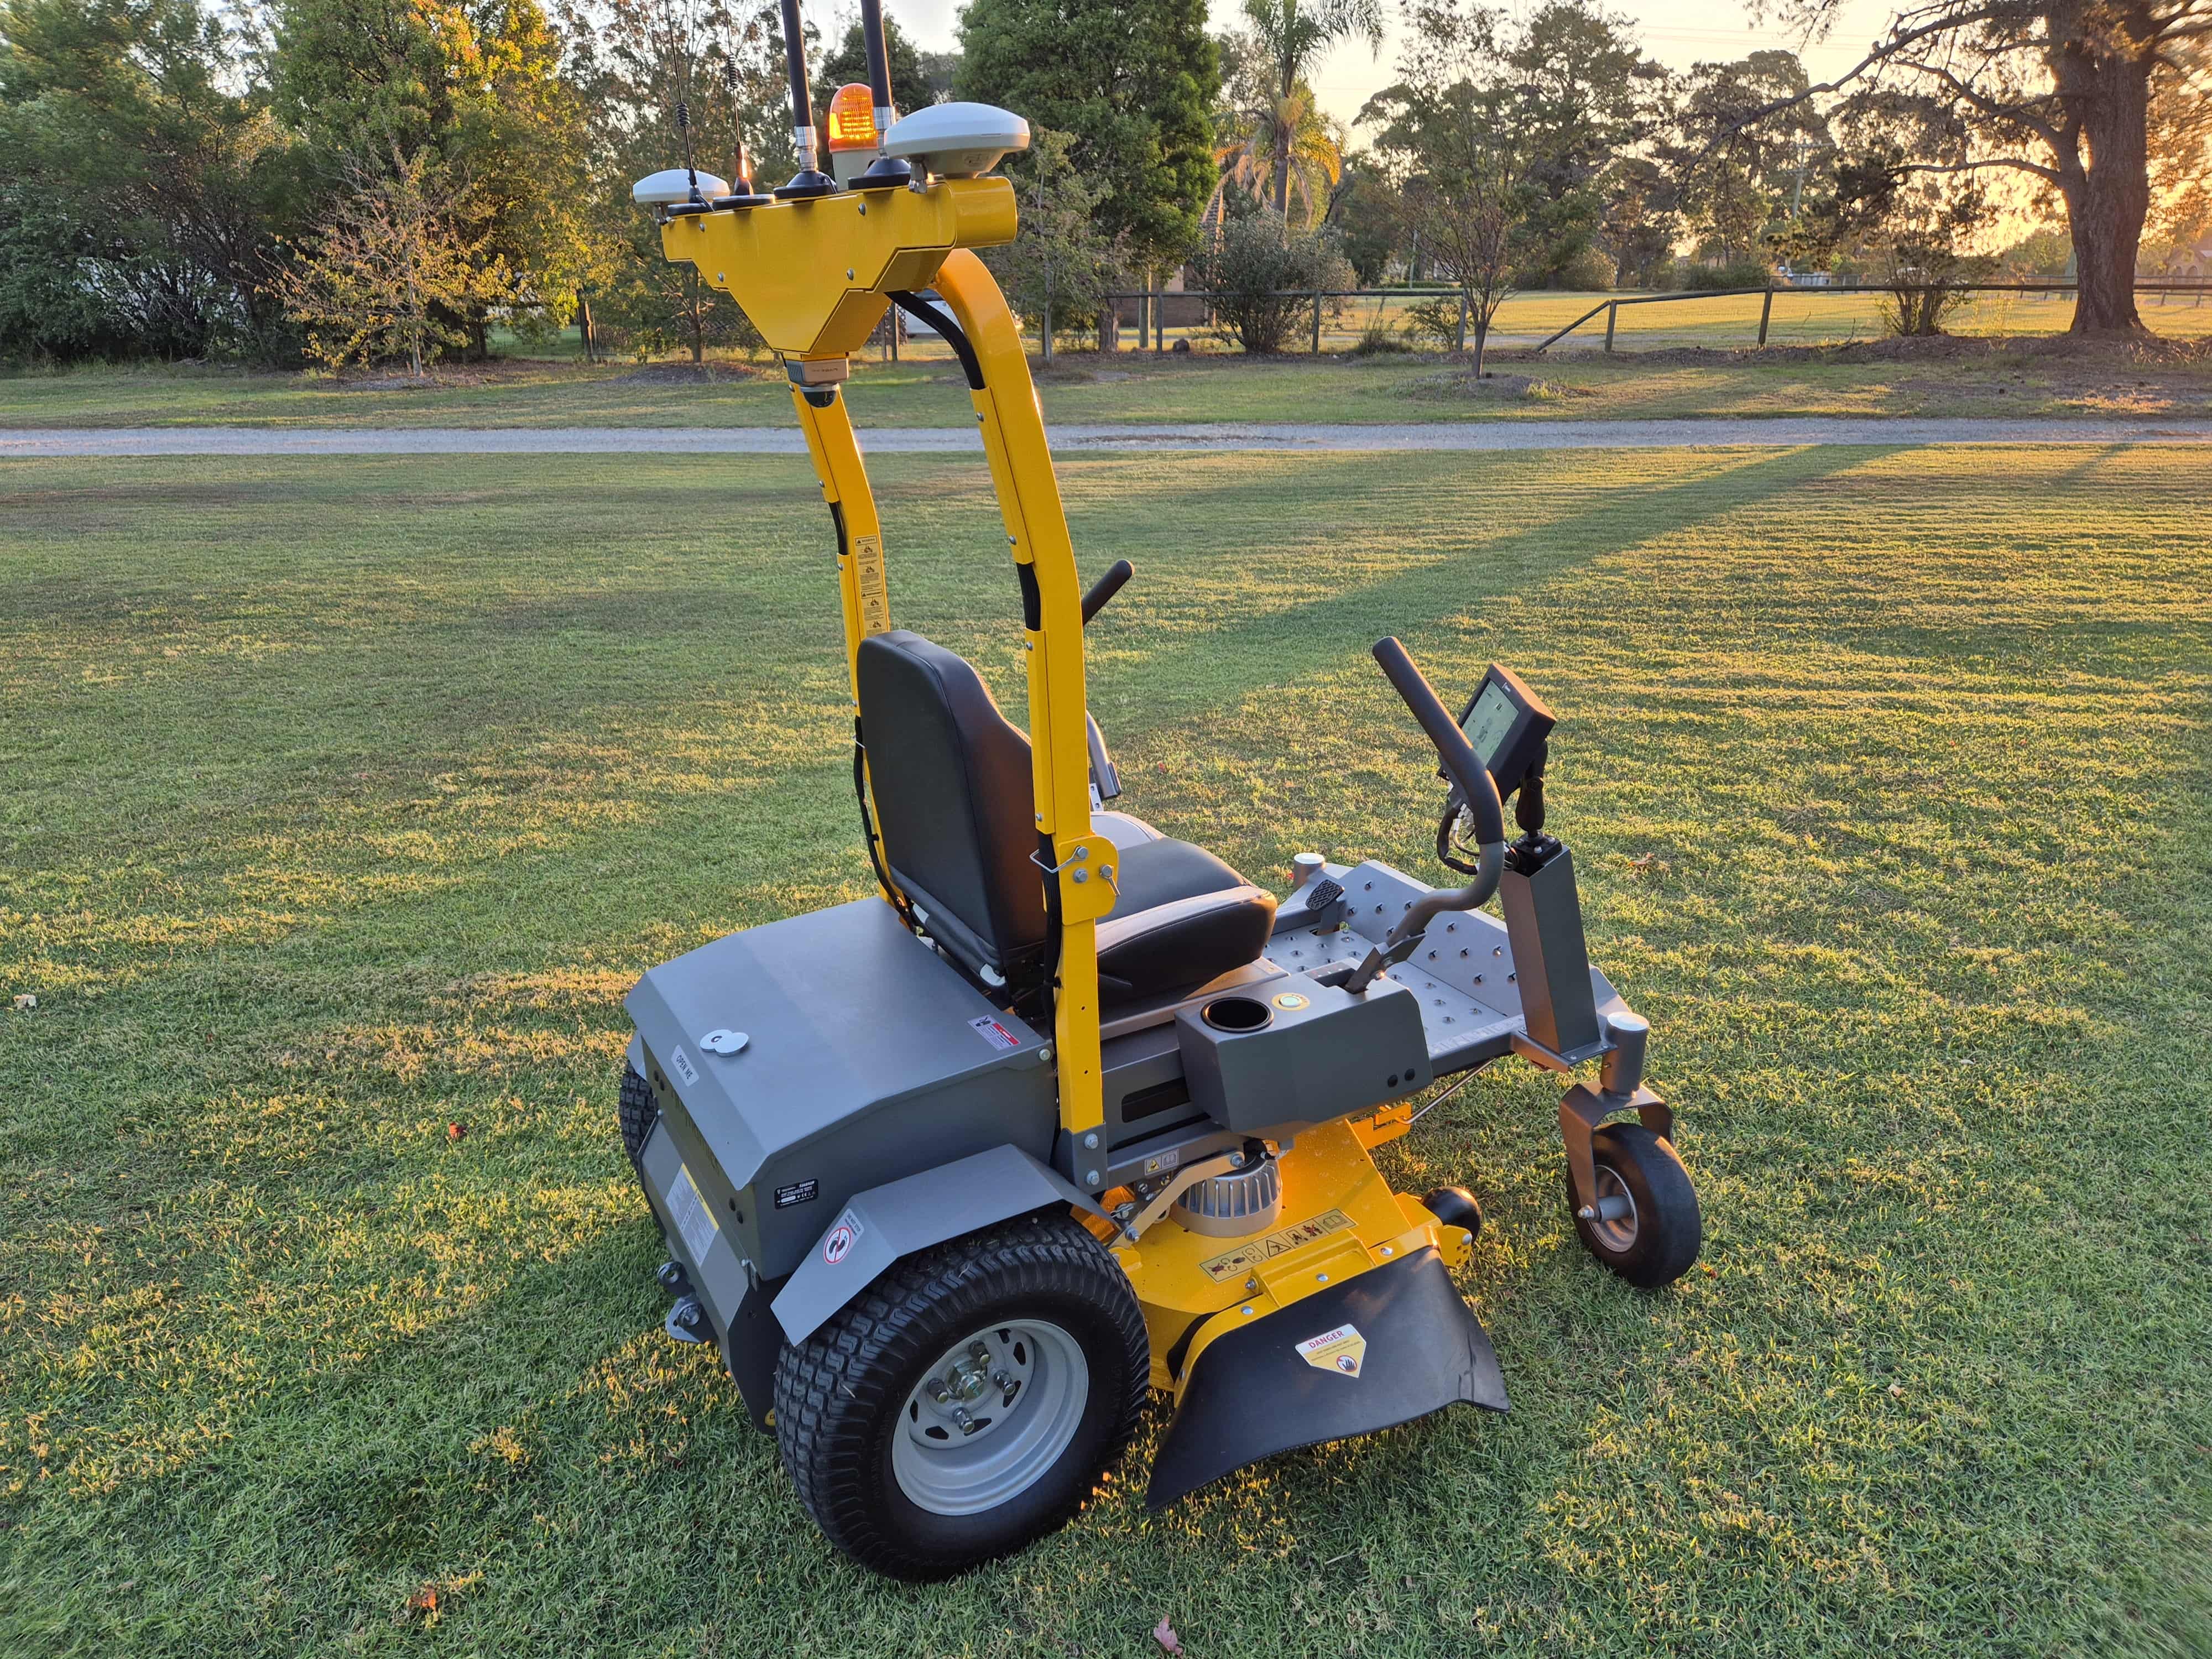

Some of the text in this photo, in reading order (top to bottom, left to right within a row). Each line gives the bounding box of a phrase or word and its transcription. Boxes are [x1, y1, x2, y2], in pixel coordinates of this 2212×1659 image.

[676, 1055, 693, 1079] OPEN ME
[1308, 1330, 1345, 1349] DANGER
